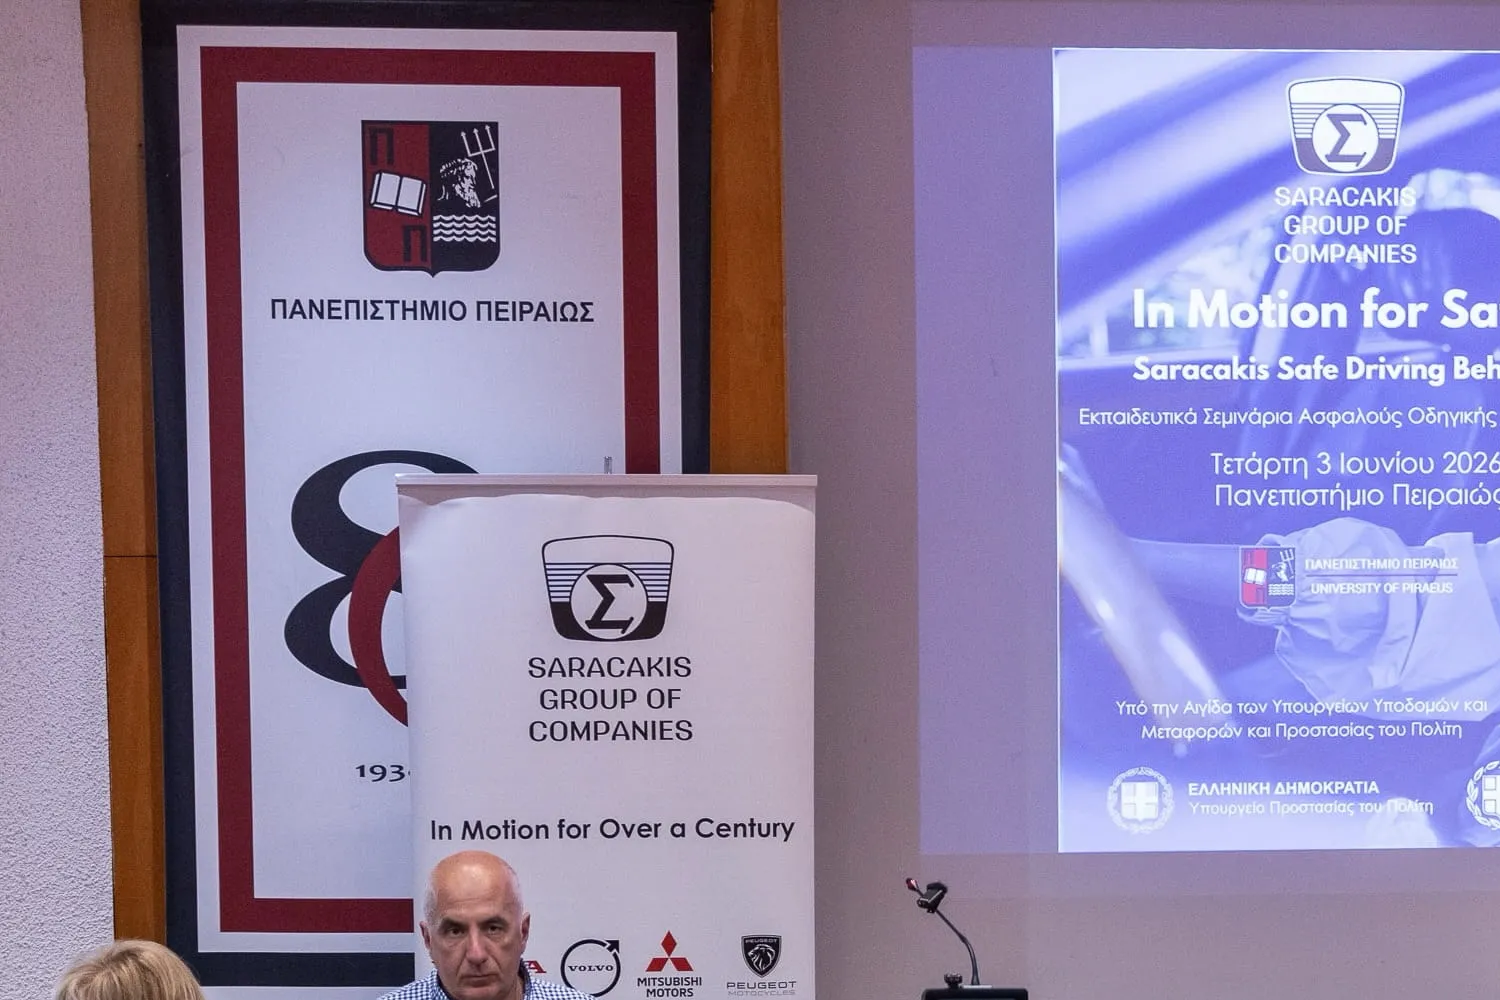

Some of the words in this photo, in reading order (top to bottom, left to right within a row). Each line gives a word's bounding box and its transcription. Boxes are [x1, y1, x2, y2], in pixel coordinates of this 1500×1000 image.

[1274, 186, 1417, 207] SARACAKIS
[1284, 215, 1369, 235] GROUP
[1376, 215, 1408, 235] OF
[1274, 244, 1417, 264] COMPANIES
[270, 298, 467, 322] ΠΑΝΕΠΙΣΤΗΜΙΟ
[475, 299, 595, 323] ΠΕΙΡΑΙΩΣ
[1133, 288, 1175, 328] In
[1188, 287, 1347, 328] Motion
[1360, 287, 1428, 328] for
[1133, 355, 1269, 381] Saracakis
[1276, 355, 1339, 381] Safe
[1346, 355, 1445, 386] Driving
[1079, 407, 1197, 425] Εκπαιδευτικά
[1203, 408, 1293, 428] Σεμινάρια
[1299, 407, 1402, 428] Ασφαλούς
[1407, 407, 1497, 428] Οδηγικής
[1210, 452, 1308, 480] Τετάρτη
[1316, 452, 1331, 475] 3
[1340, 451, 1434, 474] Ιουνίου
[1215, 483, 1384, 511] Πανεπιστήμιο
[1305, 558, 1400, 570] ΠΑΝΕΠΙΣΤΗΜΙΟ
[1311, 583, 1381, 595] UNIVERSITY
[1383, 583, 1399, 594] OF
[1402, 582, 1453, 594] PIRAEUS
[527, 656, 691, 678] SARACAKIS
[539, 688, 642, 710] GROUP
[646, 688, 683, 710] OF
[1116, 700, 1148, 716] Υπό
[1152, 703, 1178, 718] την
[1183, 699, 1233, 717] Αιγίδα
[1237, 702, 1267, 714] των
[1272, 699, 1369, 716] Υπουργείων
[1373, 698, 1459, 715] Υποδομών
[1464, 701, 1488, 712] και
[528, 719, 693, 742] COMPANIES
[1141, 723, 1243, 741] Μεταφορών
[1247, 726, 1271, 737] και
[1275, 722, 1375, 740] Προστασίας
[1378, 725, 1406, 737] του
[1411, 721, 1462, 739] Πολίτη
[355, 764, 411, 782] 193
[1188, 782, 1270, 796] ΕΛΛΗΝΙΚΗ
[1274, 781, 1380, 796] ΔΗΜΟΚΡΑΤΙΑ
[1189, 802, 1265, 817] Υπουργείο
[1270, 801, 1354, 816] Προστασίας
[1359, 802, 1383, 813] του
[431, 820, 451, 840] In
[461, 819, 549, 840] Motion
[557, 819, 591, 840] for
[600, 818, 662, 839] Over
[670, 823, 686, 838] a
[695, 817, 795, 842] Century
[568, 964, 614, 972] VOLVO
[637, 977, 702, 987] MITSUBISHI
[726, 981, 797, 990] PEUGEOT
[646, 988, 694, 998] MOTORS
